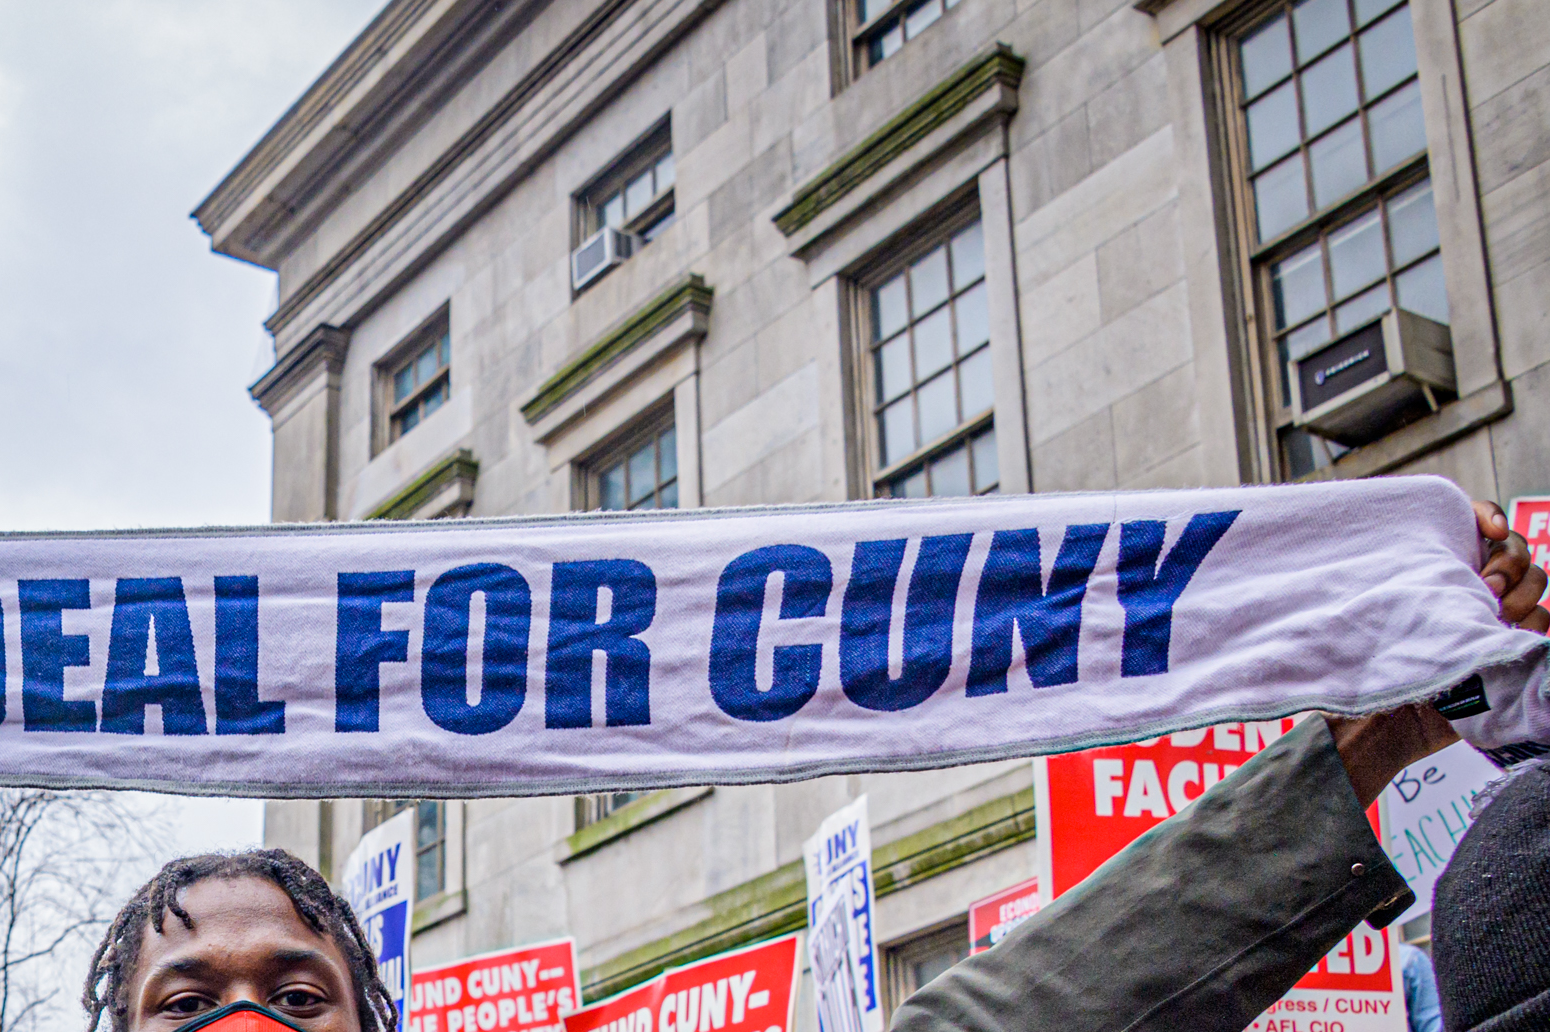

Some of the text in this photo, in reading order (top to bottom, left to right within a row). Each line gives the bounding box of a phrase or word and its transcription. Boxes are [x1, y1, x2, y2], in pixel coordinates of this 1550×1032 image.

[335, 558, 657, 735] FOR
[709, 509, 1241, 722] CUNY
[1391, 766, 1446, 803] Be
[1308, 922, 1387, 975] ED
[1335, 998, 1392, 1015] CUNY
